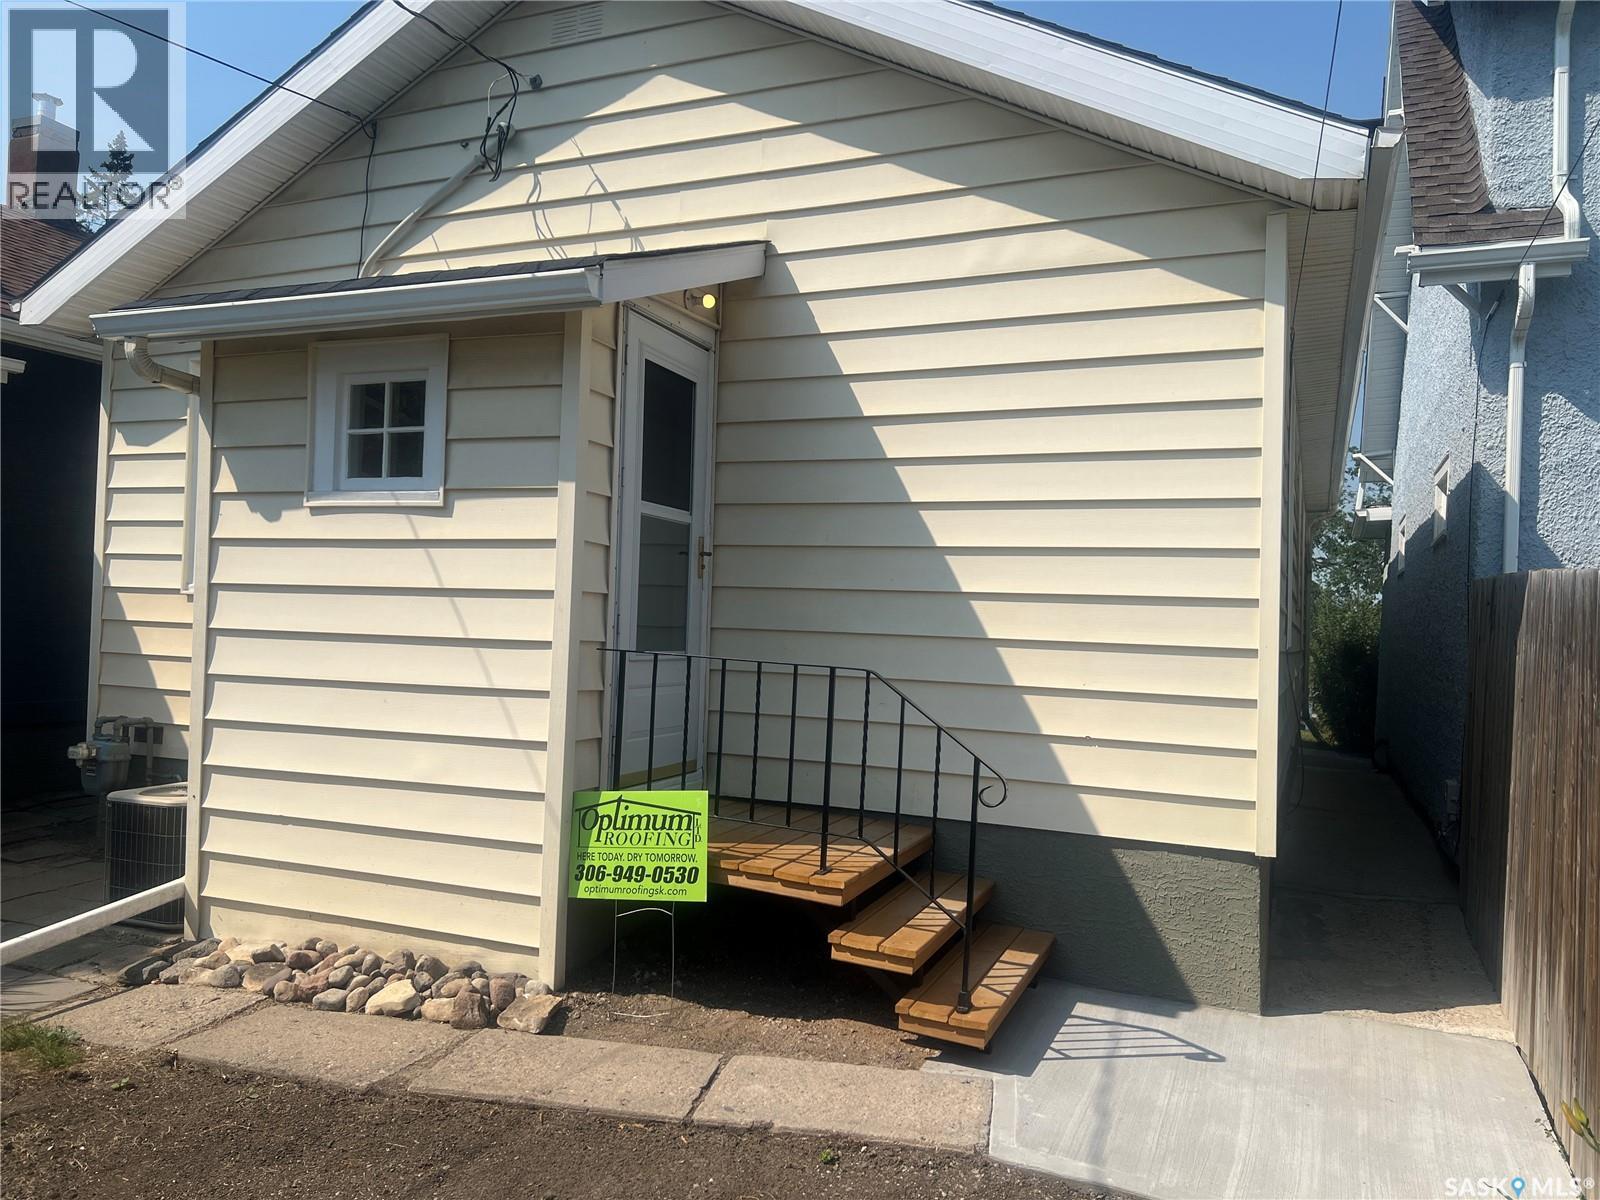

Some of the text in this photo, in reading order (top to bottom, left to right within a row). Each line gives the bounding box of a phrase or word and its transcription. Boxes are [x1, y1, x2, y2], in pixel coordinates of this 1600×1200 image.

[581, 795, 693, 843] Optimum
[604, 831, 692, 847] ROOFING
[576, 852, 698, 863] HERE TODAY. DRY TOMORROW.
[574, 864, 700, 885] 306-949-0530
[584, 884, 688, 898] optimumroofingsk.com
